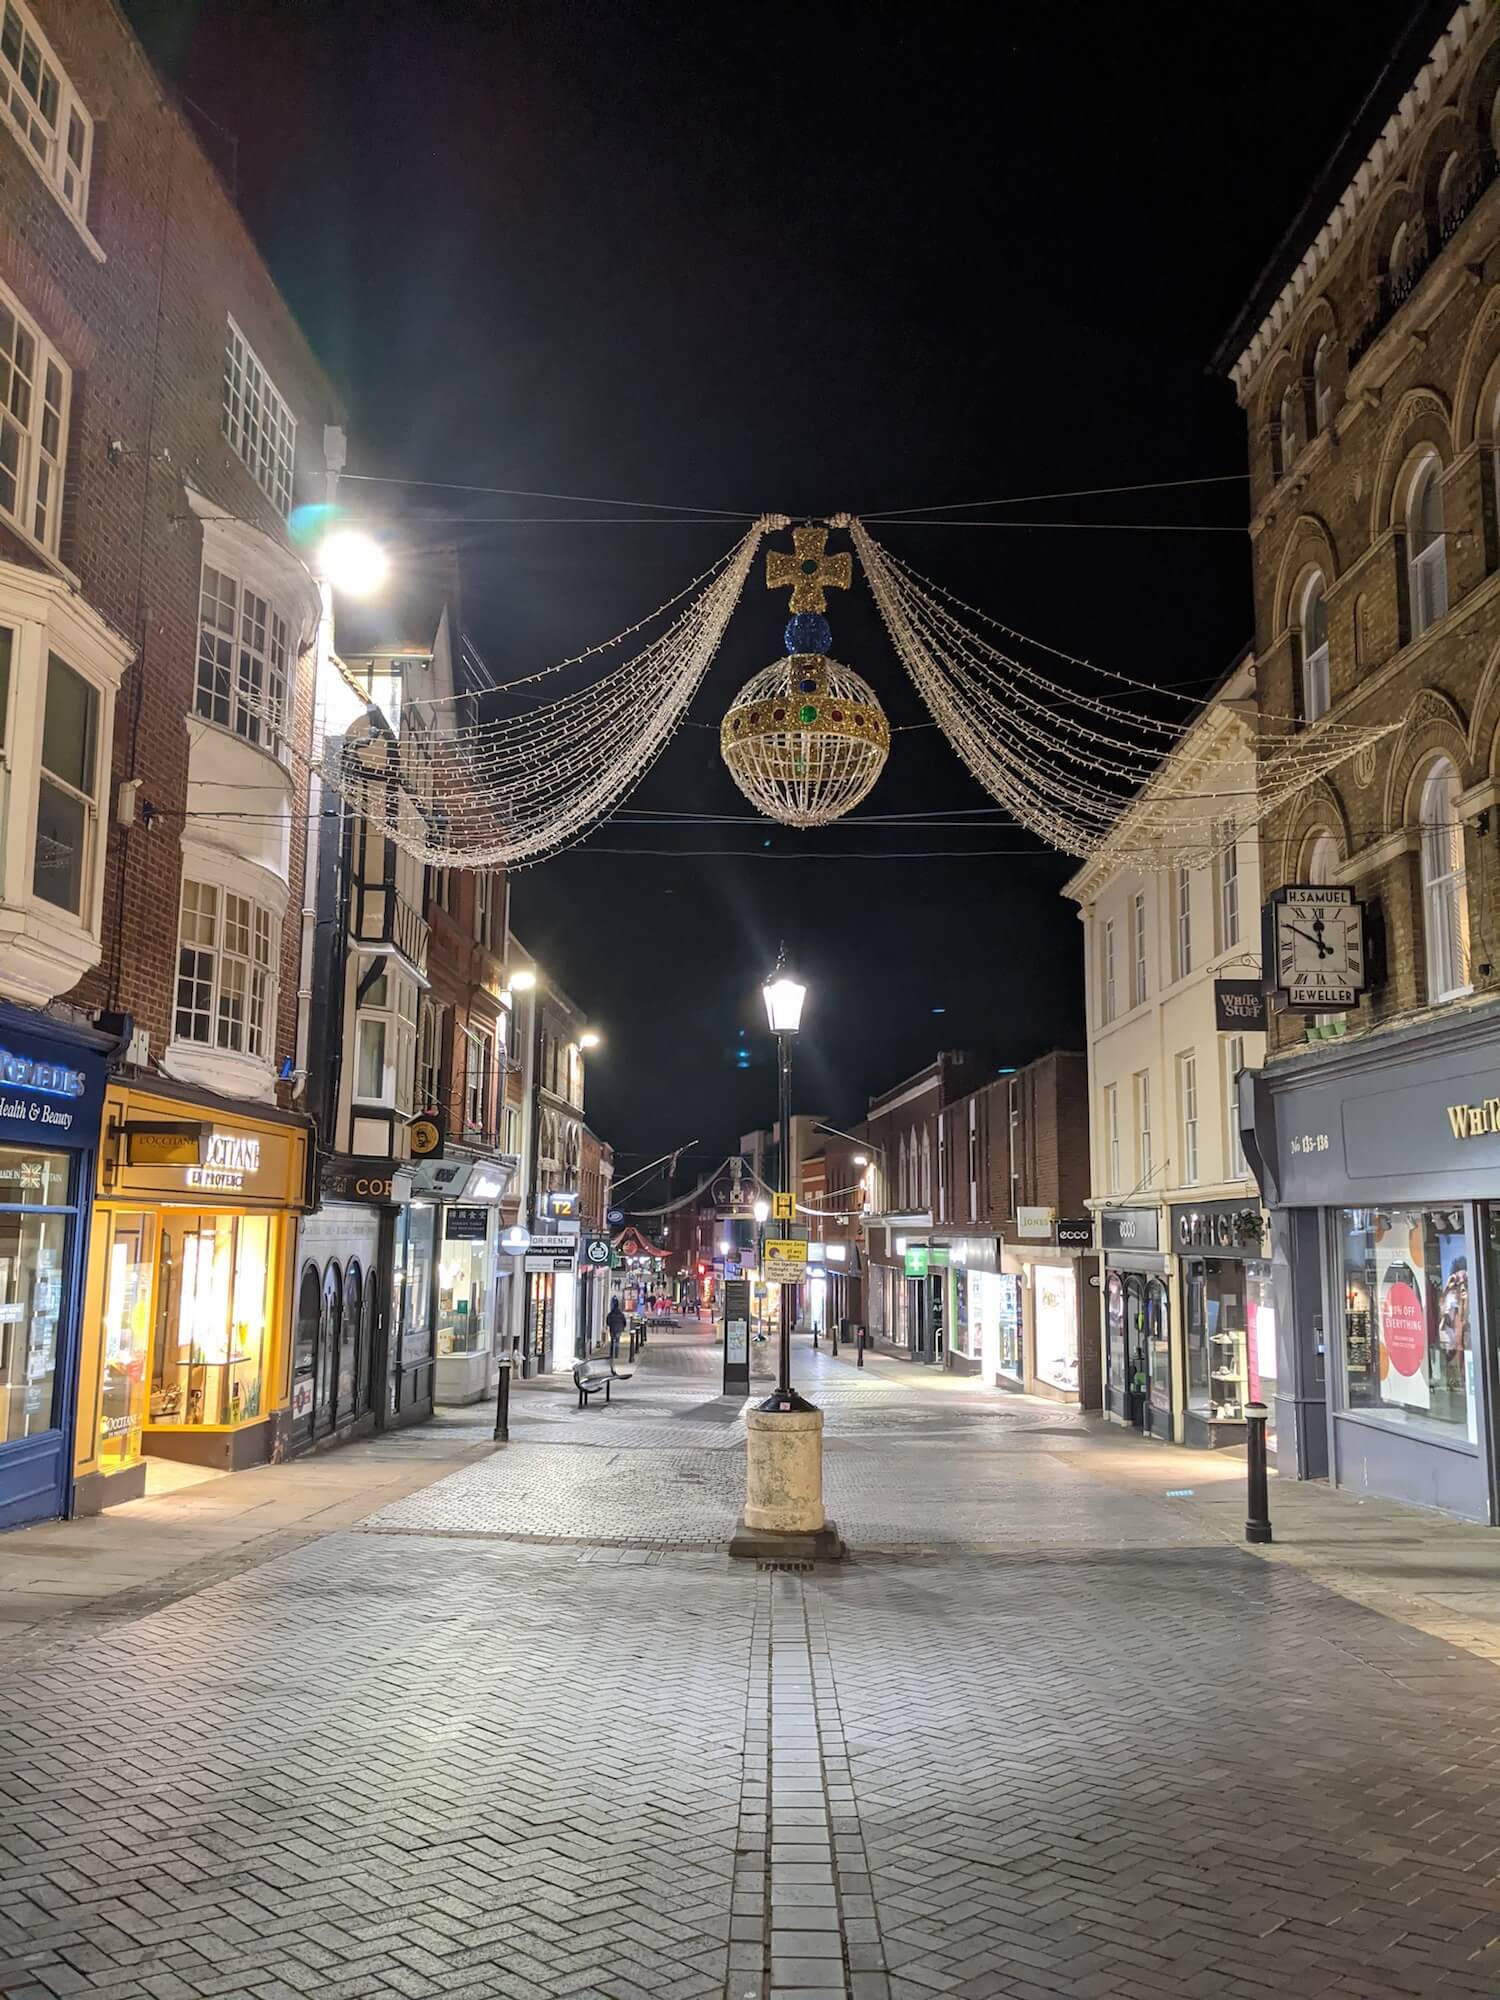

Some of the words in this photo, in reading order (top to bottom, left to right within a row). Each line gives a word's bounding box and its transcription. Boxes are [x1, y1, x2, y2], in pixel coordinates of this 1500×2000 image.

[1294, 990, 1353, 1001] JEWELLER
[28, 1102, 40, 1121] &
[41, 1105, 73, 1130] Beauty
[552, 1201, 572, 1215] T2
[777, 1196, 792, 1216] H
[547, 1237, 568, 1245] RENT
[1059, 1230, 1089, 1240] ecco
[1385, 1318, 1422, 1331] EVERYTHING
